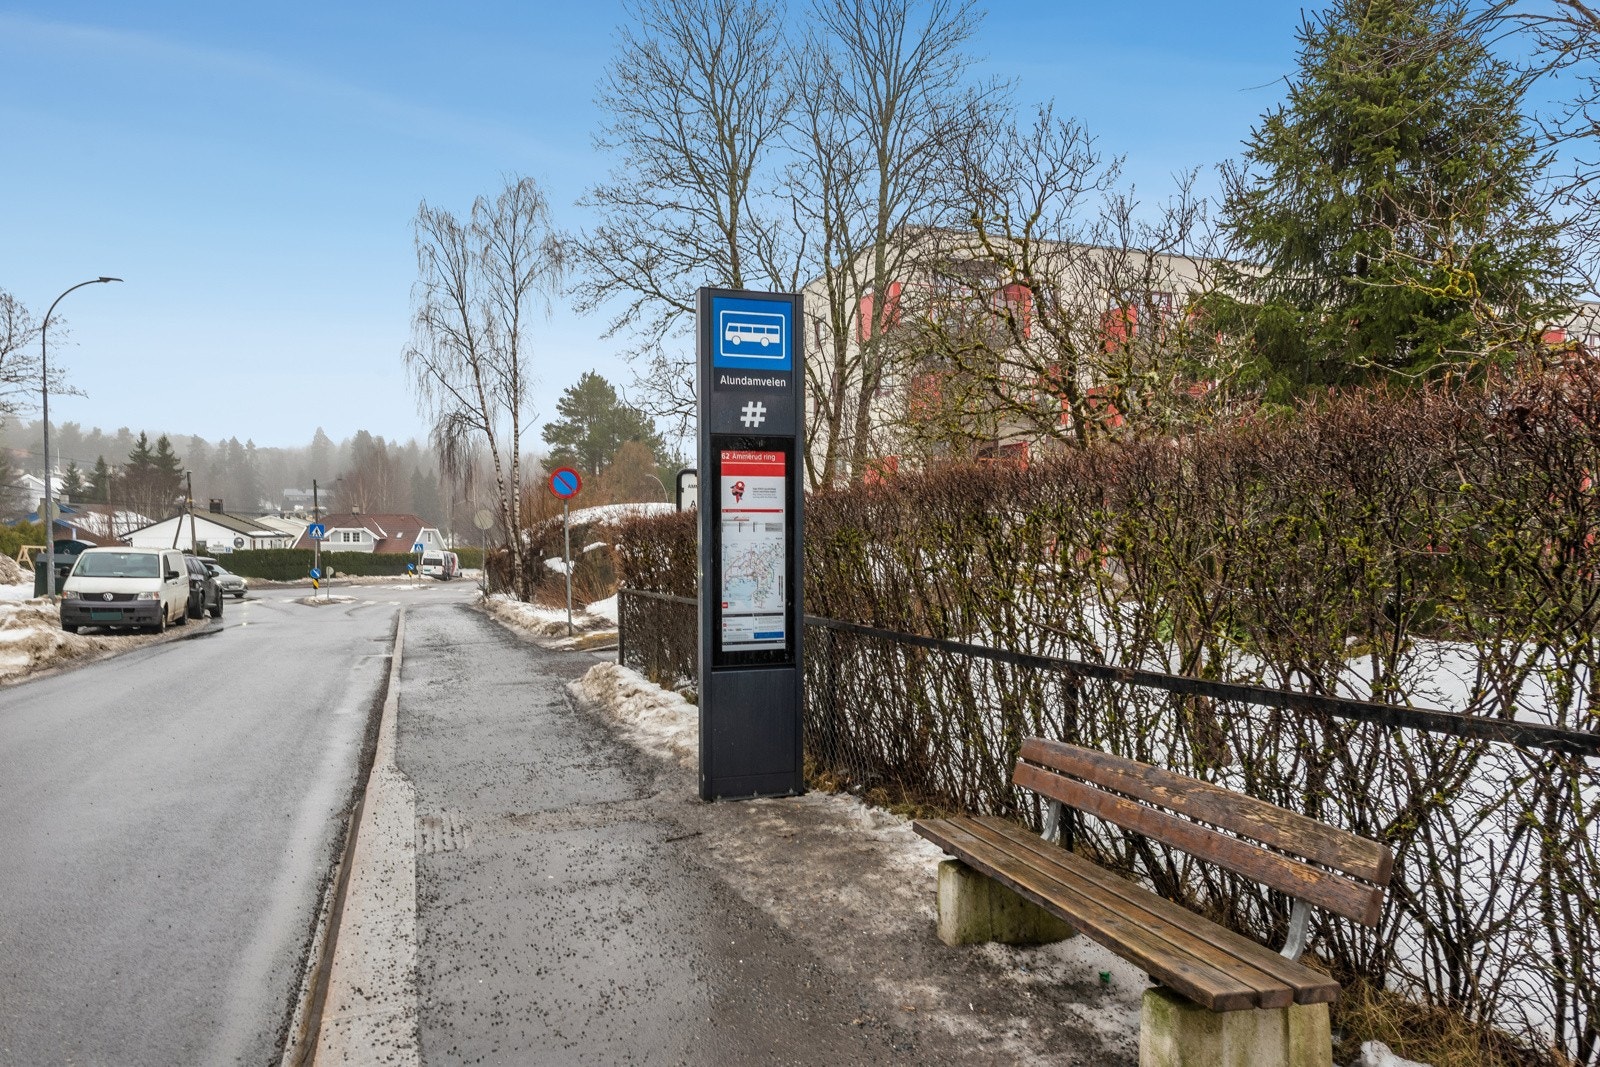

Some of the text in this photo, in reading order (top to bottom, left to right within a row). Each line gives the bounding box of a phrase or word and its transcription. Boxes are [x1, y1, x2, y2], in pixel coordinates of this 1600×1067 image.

[720, 375, 786, 387] Alundamveien
[721, 452, 730, 460] 62
[763, 454, 776, 462] ring
